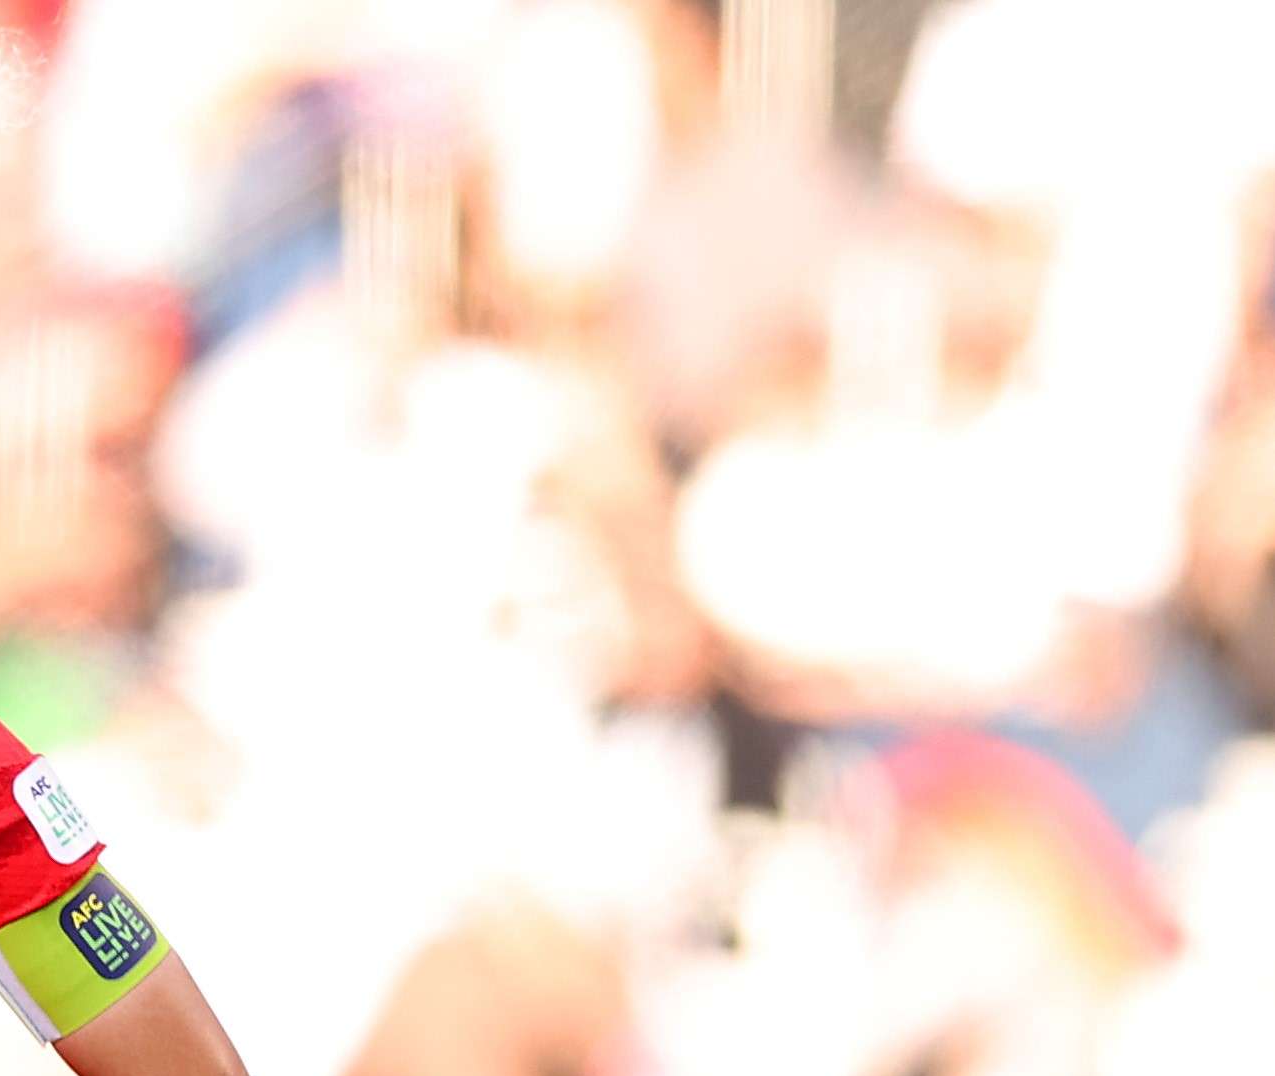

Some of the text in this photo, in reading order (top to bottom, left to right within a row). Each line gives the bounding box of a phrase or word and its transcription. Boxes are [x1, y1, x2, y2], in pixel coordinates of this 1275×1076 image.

[30, 775, 51, 801] AFC
[71, 893, 103, 930] AFC
[79, 894, 134, 950] LIVE
[96, 915, 145, 965] LIVE
